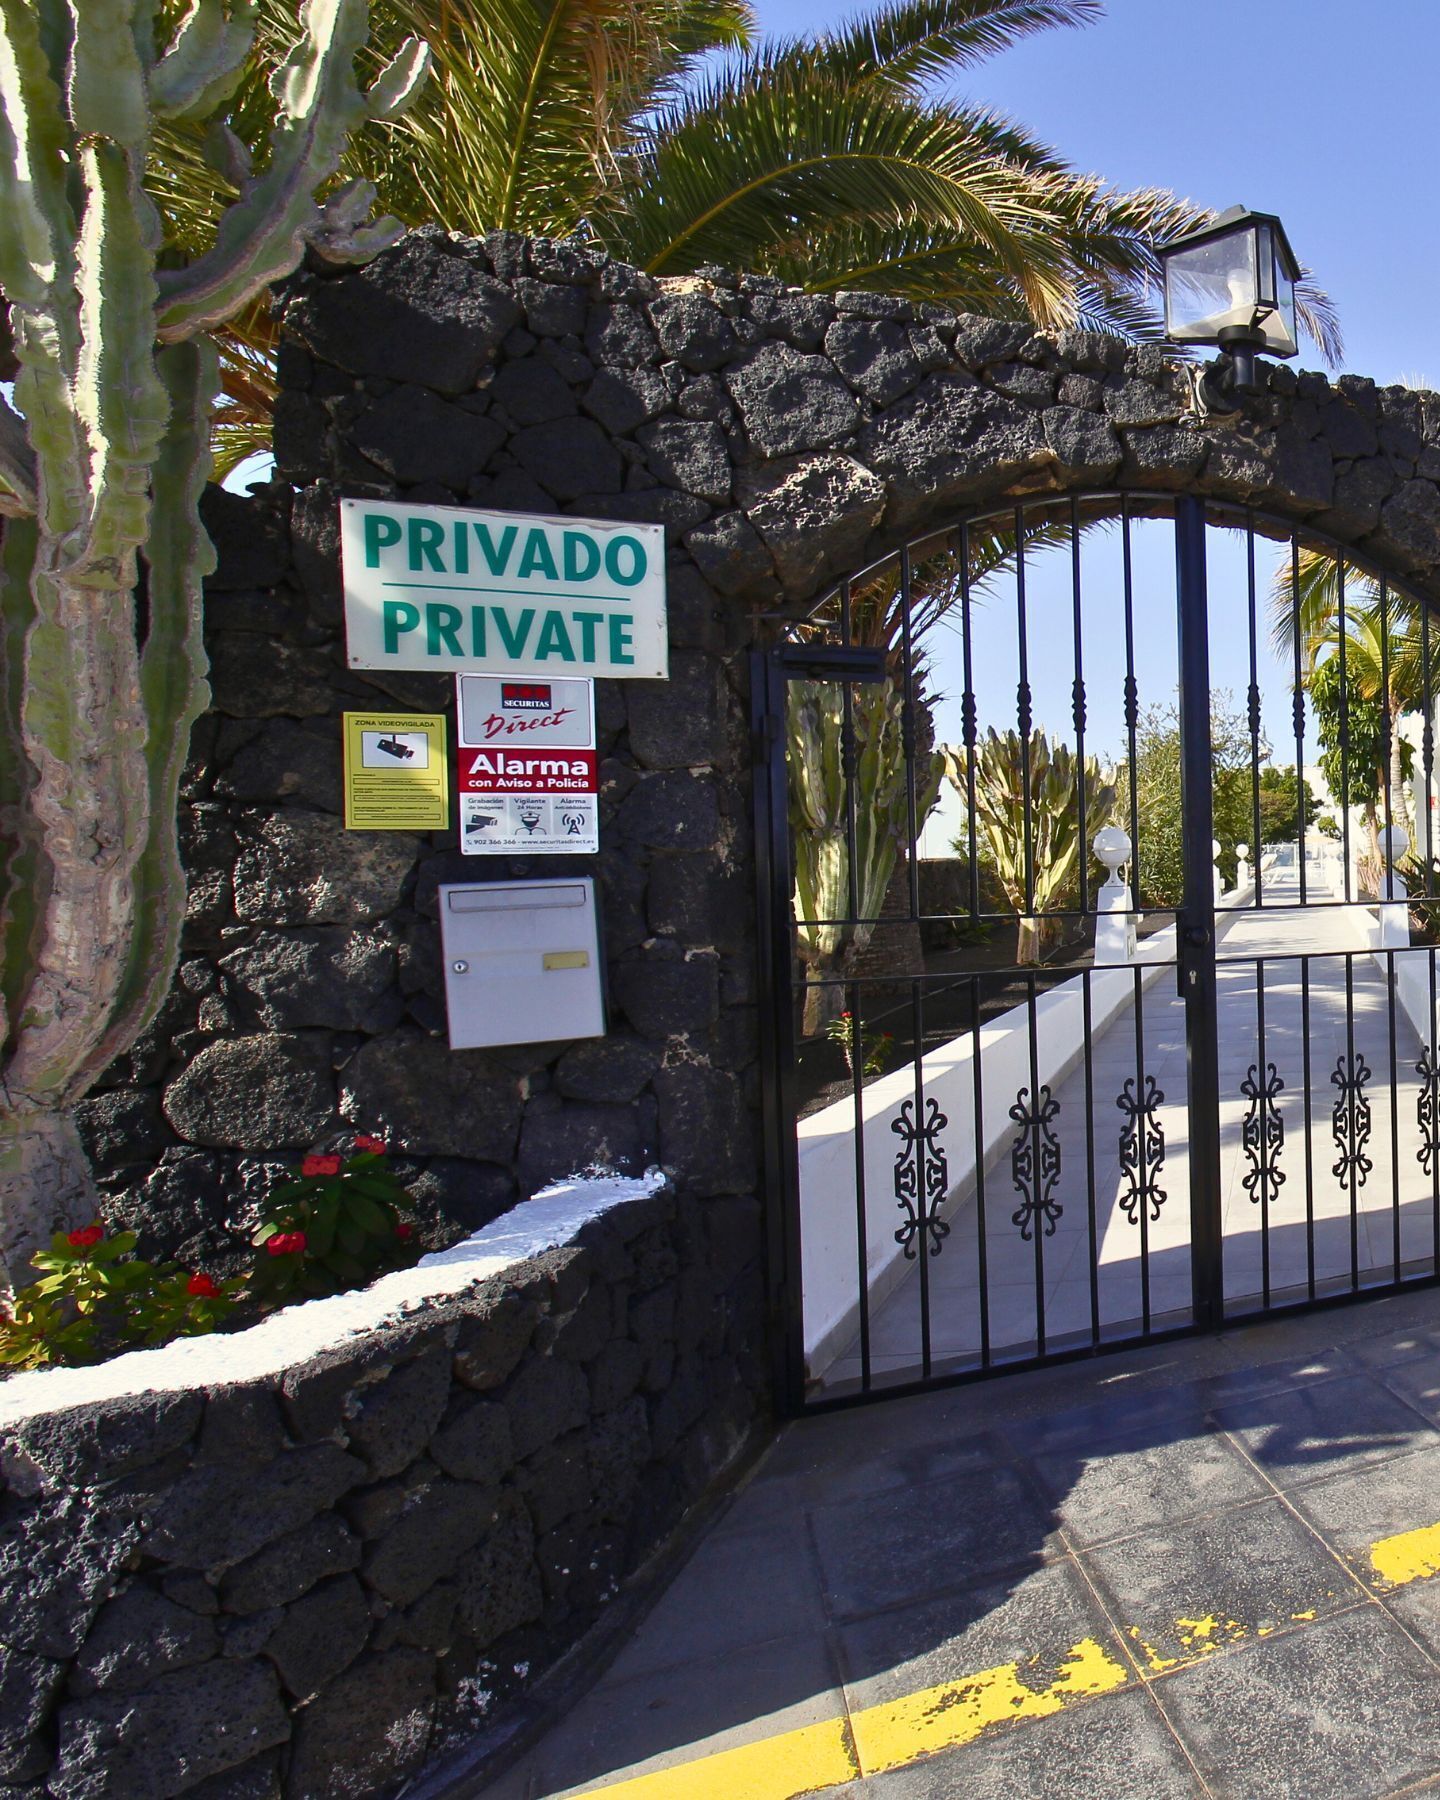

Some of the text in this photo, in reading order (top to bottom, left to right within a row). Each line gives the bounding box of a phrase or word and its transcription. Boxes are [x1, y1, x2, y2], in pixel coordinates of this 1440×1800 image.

[363, 513, 648, 587] PRIVADO
[383, 599, 636, 665] PRIVATE
[503, 700, 550, 708] SECURITAS
[378, 720, 435, 728] VIDEOVIGILADA
[481, 707, 577, 740] Direct
[468, 752, 589, 776] Alarma
[468, 778, 589, 789] con Aviso a Policía
[513, 797, 546, 805] Vigilante
